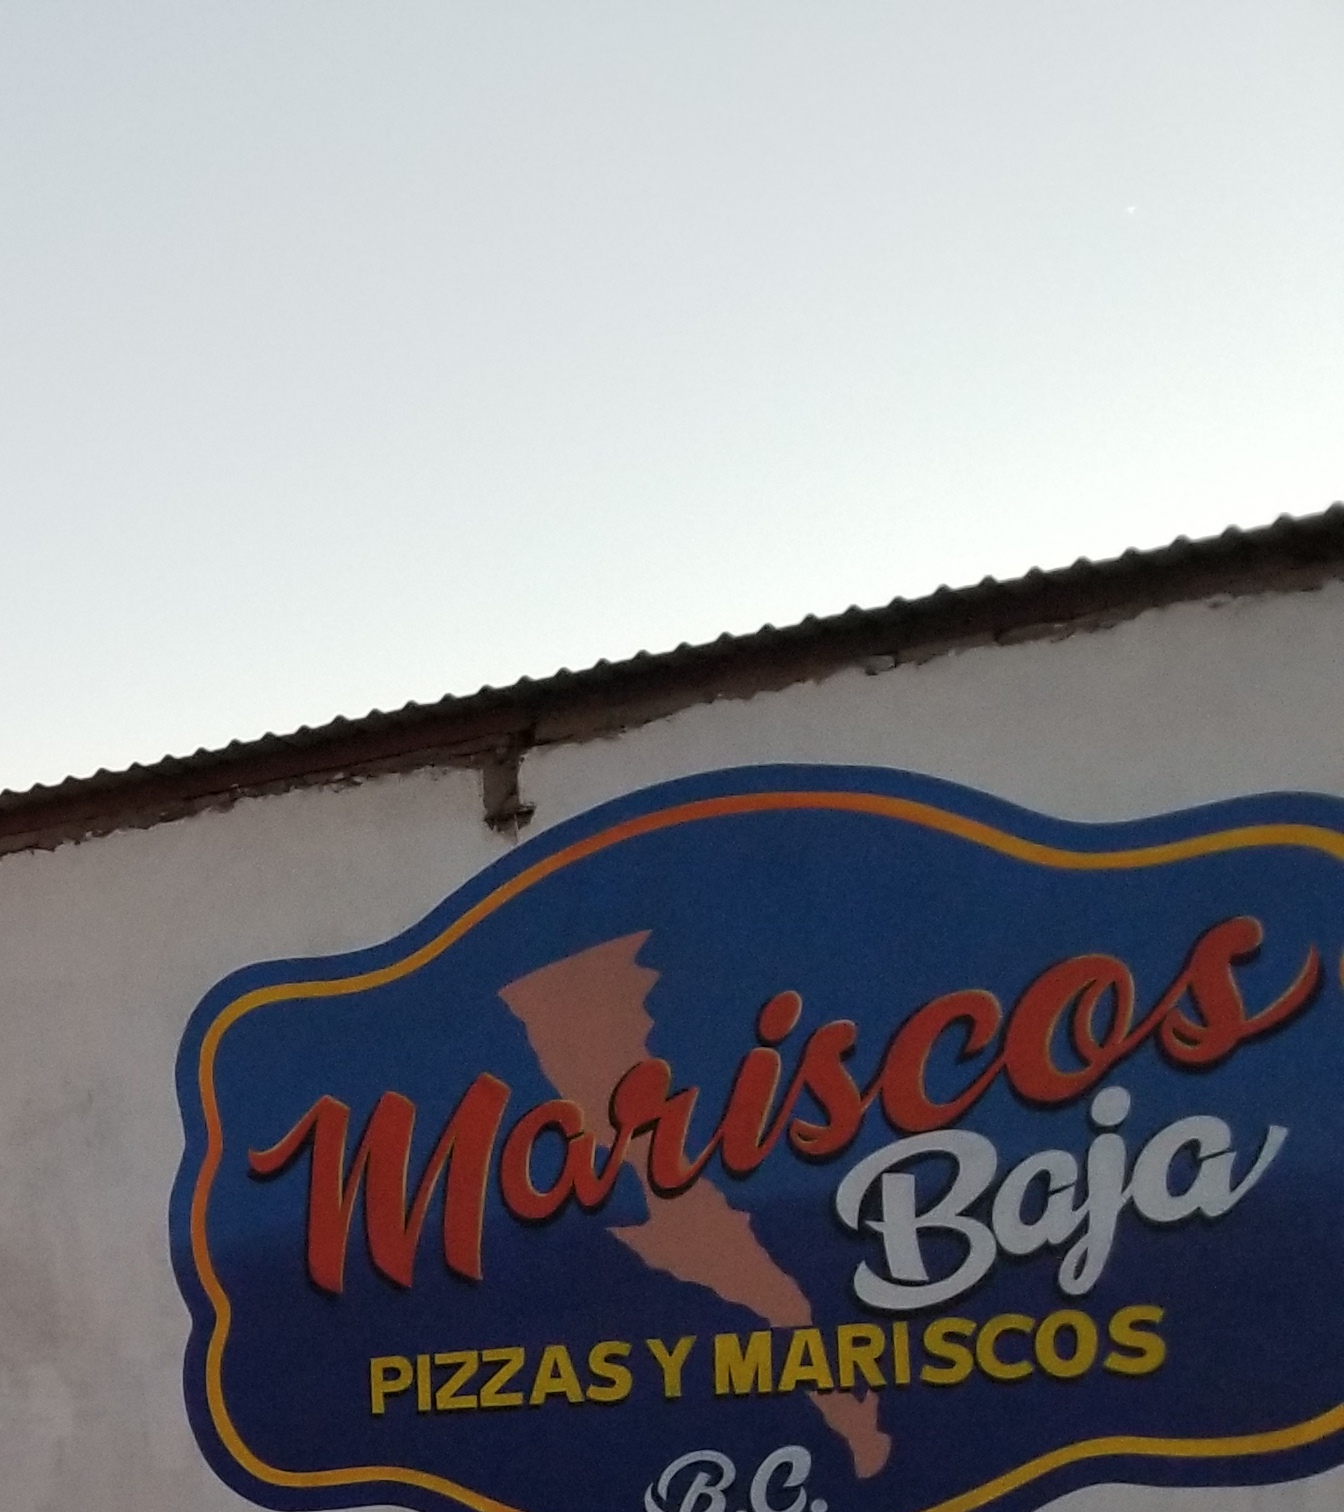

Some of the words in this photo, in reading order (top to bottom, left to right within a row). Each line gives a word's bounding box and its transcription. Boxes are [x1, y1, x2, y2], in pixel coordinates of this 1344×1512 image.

[248, 914, 1320, 1292] Mariscos
[836, 1085, 1289, 1310] Baja
[369, 1340, 632, 1415] PIZZAS
[647, 1336, 692, 1397] Y
[714, 1306, 1165, 1394] MARISCOS
